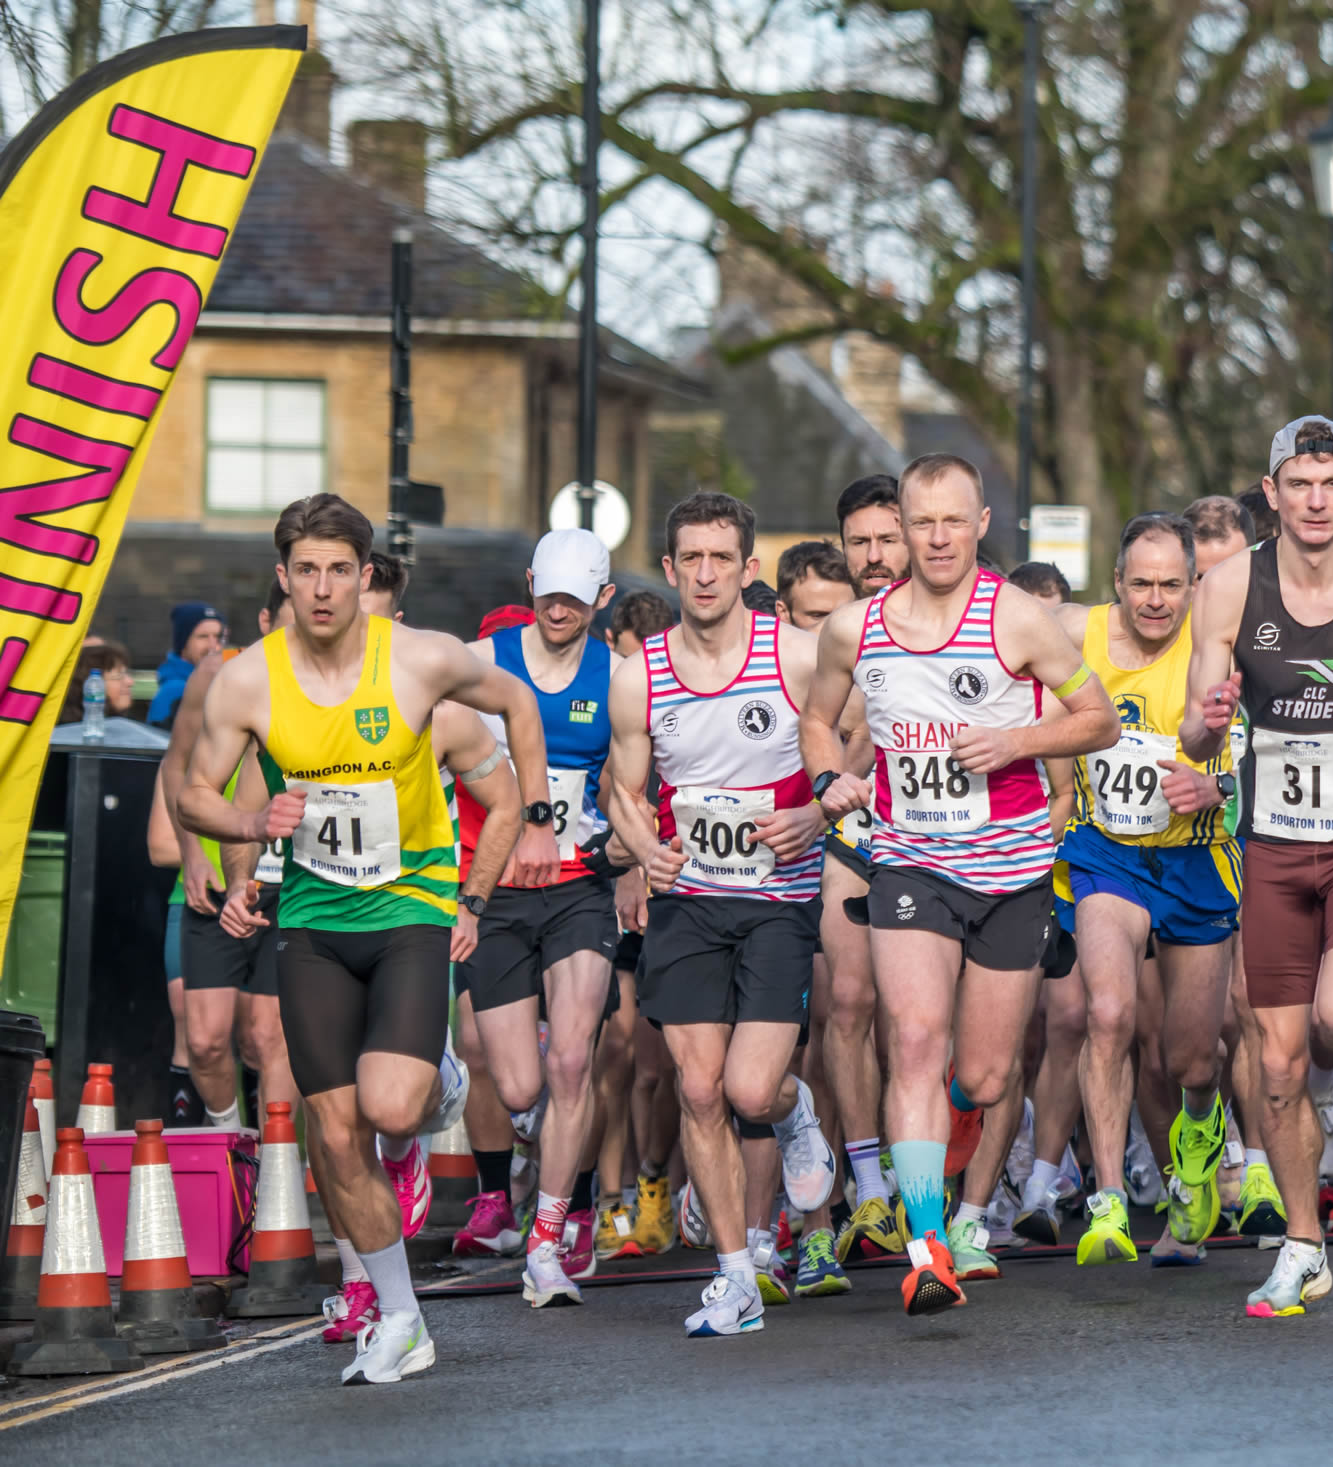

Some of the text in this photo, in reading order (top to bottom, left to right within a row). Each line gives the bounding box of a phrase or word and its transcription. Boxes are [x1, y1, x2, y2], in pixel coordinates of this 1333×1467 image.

[1303, 687, 1327, 700] CLC
[571, 712, 592, 722] run
[287, 760, 396, 779] ABINGDON A.C.
[898, 756, 970, 800] 348
[1095, 758, 1158, 806] 249
[1282, 763, 1321, 808] 31
[906, 809, 970, 822] BOURTON 10K
[1136, 815, 1153, 824] 10K
[1270, 812, 1315, 829] BOURTON
[317, 816, 362, 856] 41
[689, 818, 759, 859] 400
[310, 858, 381, 877] BOURTON 10K
[691, 858, 758, 877] BOURTON 10K
